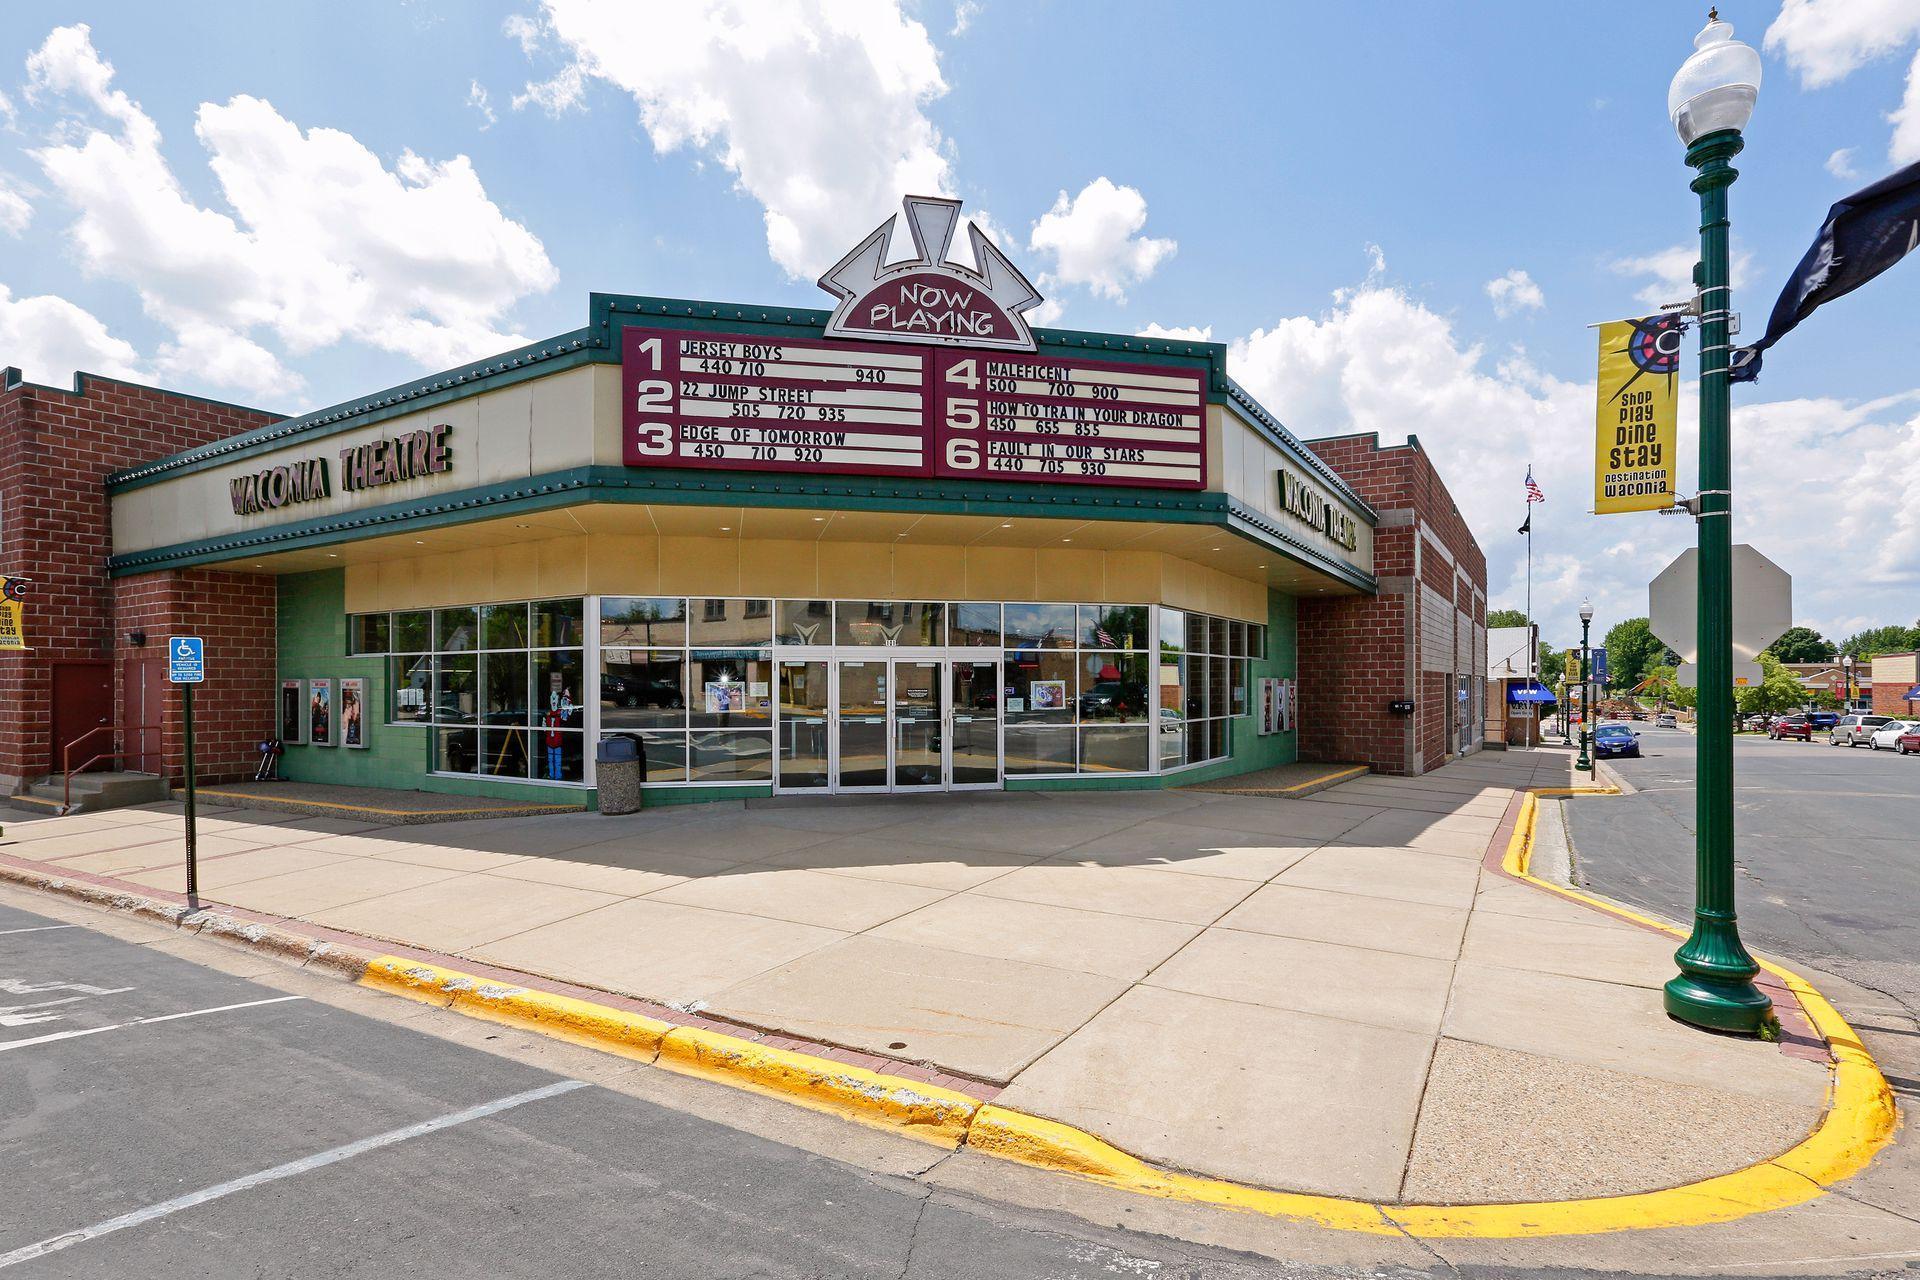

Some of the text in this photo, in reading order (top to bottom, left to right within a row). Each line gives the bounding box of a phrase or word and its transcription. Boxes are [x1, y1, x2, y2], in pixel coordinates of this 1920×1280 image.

[900, 283, 973, 310] NOW
[870, 304, 994, 335] PLAYING
[638, 338, 662, 371] 1
[681, 340, 783, 360] JERSEY BOYS
[699, 360, 886, 383] 440 710 940
[945, 358, 980, 390] 4
[988, 362, 1072, 381] MALEFICENT
[637, 380, 673, 414] 2
[682, 382, 814, 403] 22 JUMP STREET
[989, 379, 1119, 400] 500 700 900
[732, 404, 846, 422] 505 720 935
[945, 398, 980, 430] 5
[990, 402, 1183, 427] HOW TO TRAIN YOUR DRAGON
[680, 425, 846, 447] EDGE OF TOMORROW
[990, 418, 1100, 436] 450 655 855
[1616, 423, 1657, 446] Dine
[637, 422, 673, 457] 3
[693, 444, 823, 462] 450 710 920
[945, 438, 980, 470] 6
[990, 441, 1145, 462] FAULT IN OUR STARS
[1610, 443, 1662, 470] Stay
[229, 424, 453, 516] WACONIA THEATRE
[993, 458, 1106, 475] 440 705 930
[1278, 469, 1357, 552] WACONIA THEE
[0, 626, 16, 635] tay
